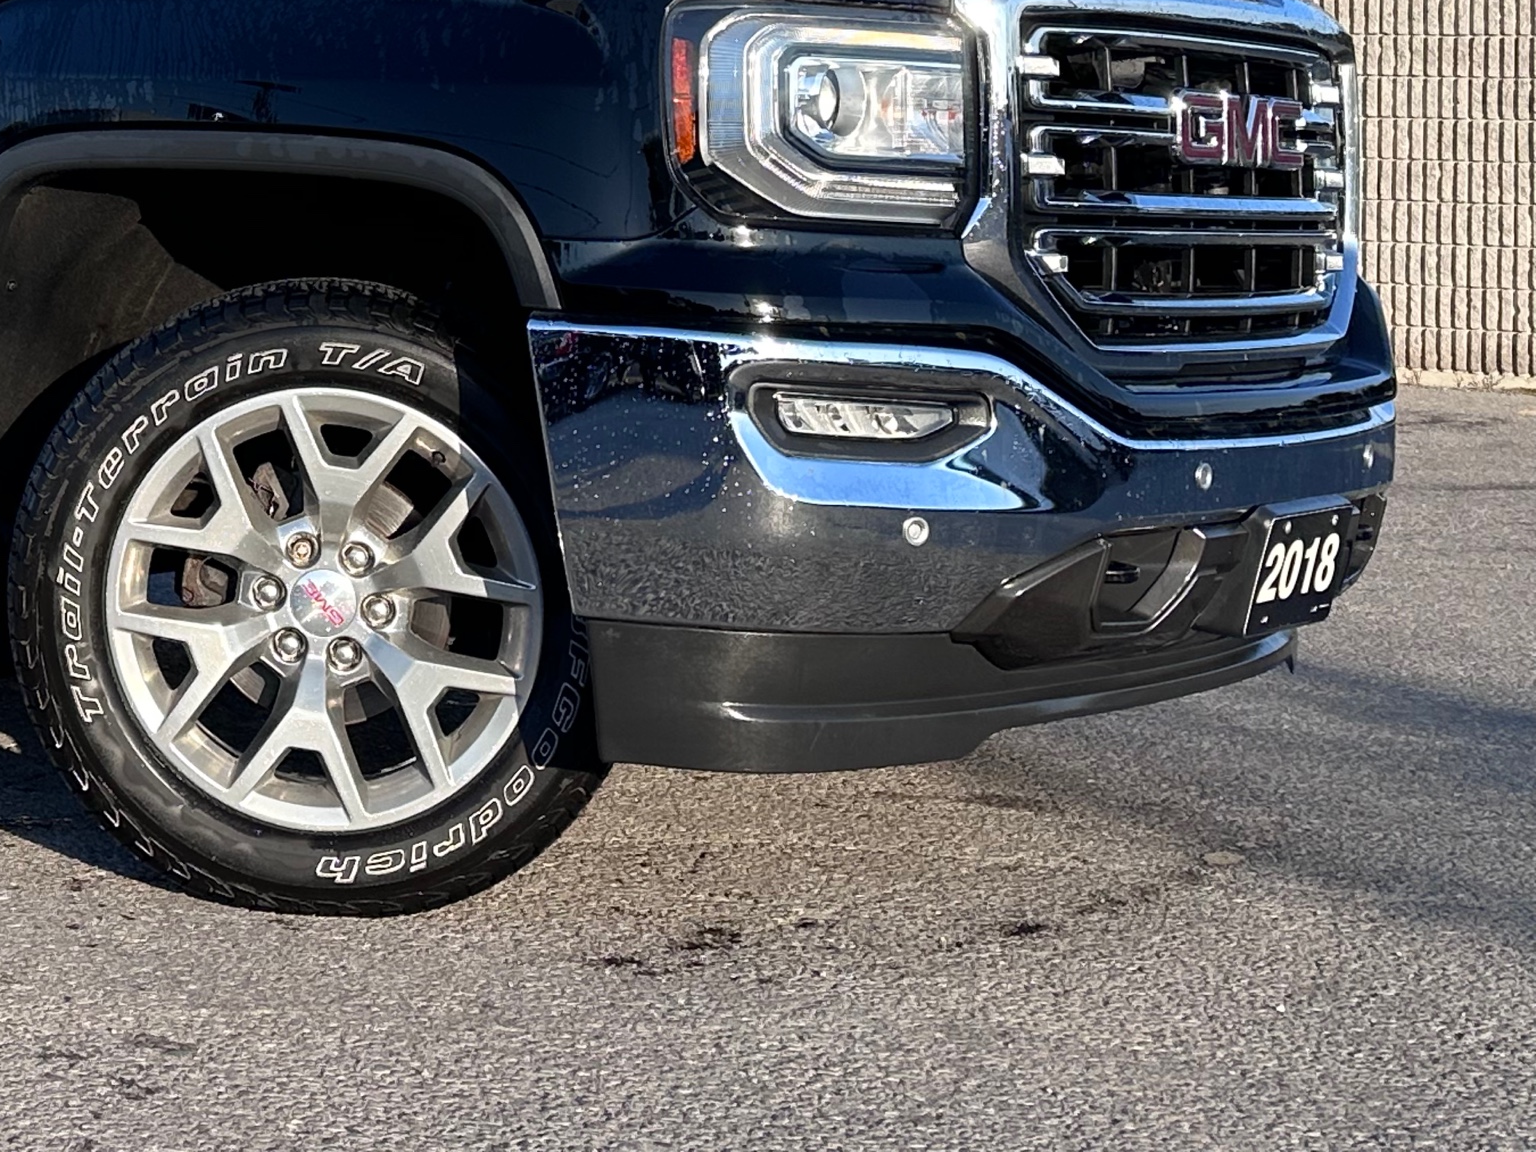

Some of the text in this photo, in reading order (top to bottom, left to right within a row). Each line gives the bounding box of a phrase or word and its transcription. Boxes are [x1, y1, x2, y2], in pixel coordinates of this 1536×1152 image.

[1172, 88, 1305, 169] GMC
[56, 342, 425, 724] Trail-Terrain T/A
[1255, 532, 1342, 604] 2018
[300, 578, 345, 628] GMC
